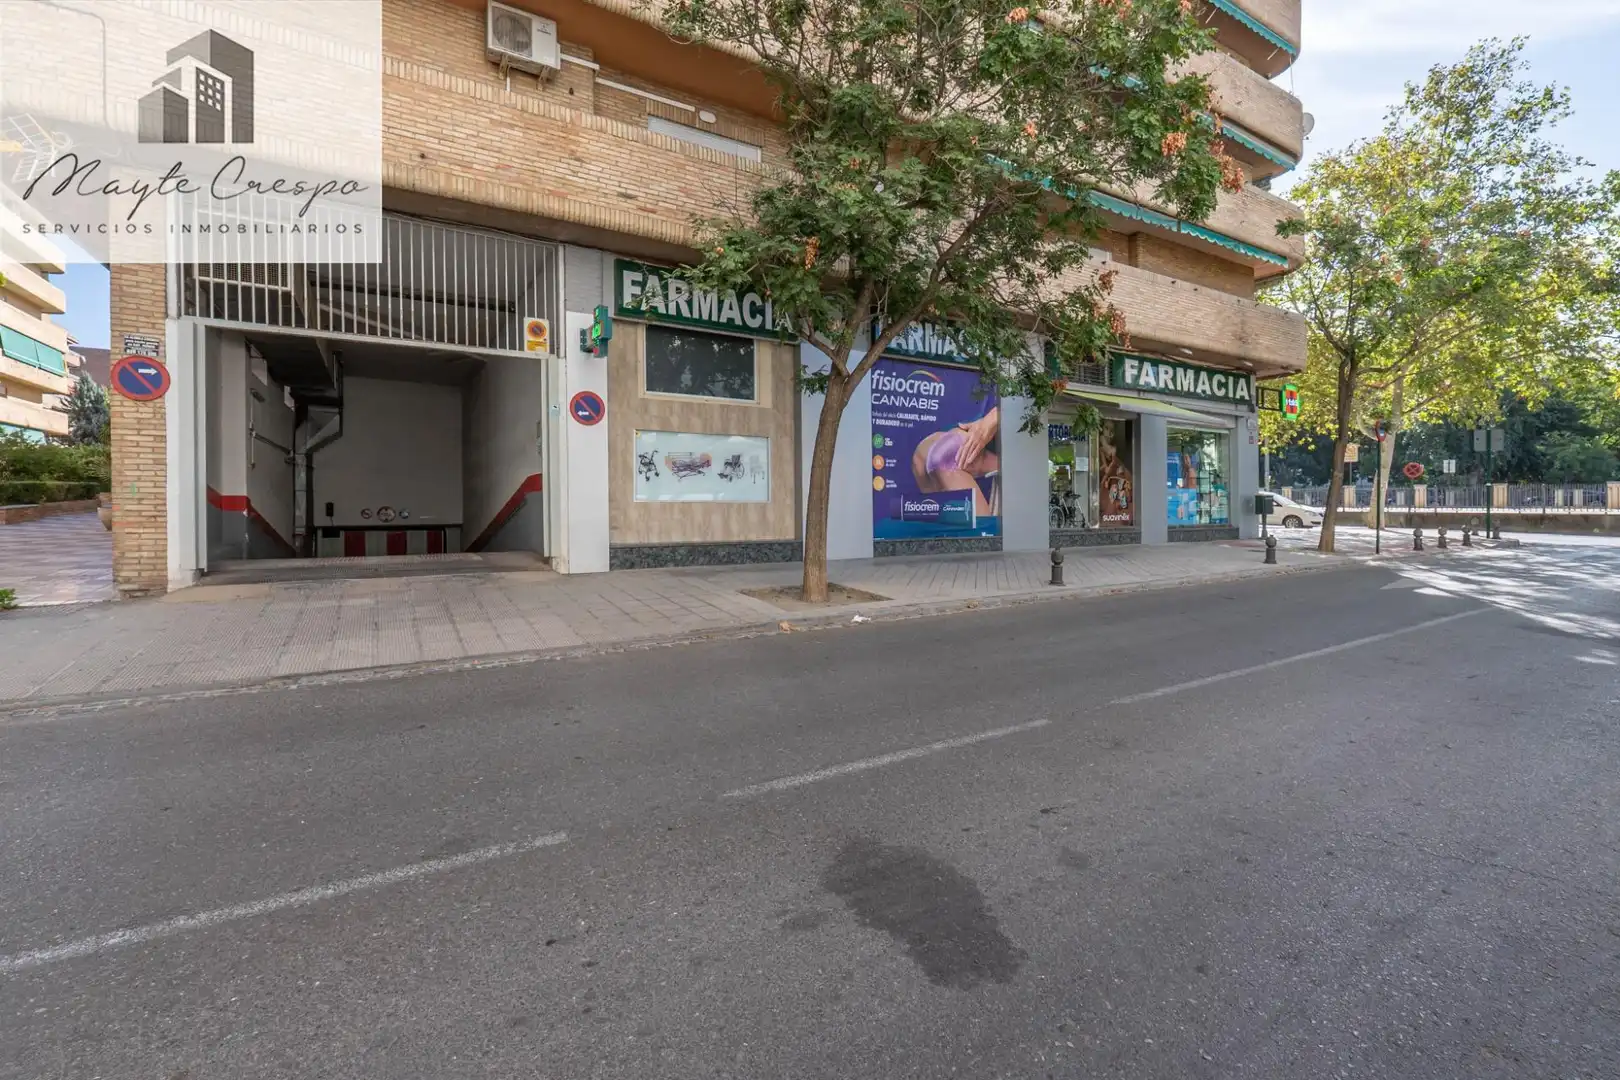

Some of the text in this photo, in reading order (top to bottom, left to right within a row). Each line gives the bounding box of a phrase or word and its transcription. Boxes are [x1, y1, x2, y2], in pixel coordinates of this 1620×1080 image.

[871, 370, 945, 397] fisiocrem
[1123, 357, 1250, 401] FARMACIA
[871, 393, 939, 410] CANNABIS
[904, 499, 940, 512] fisiocrem
